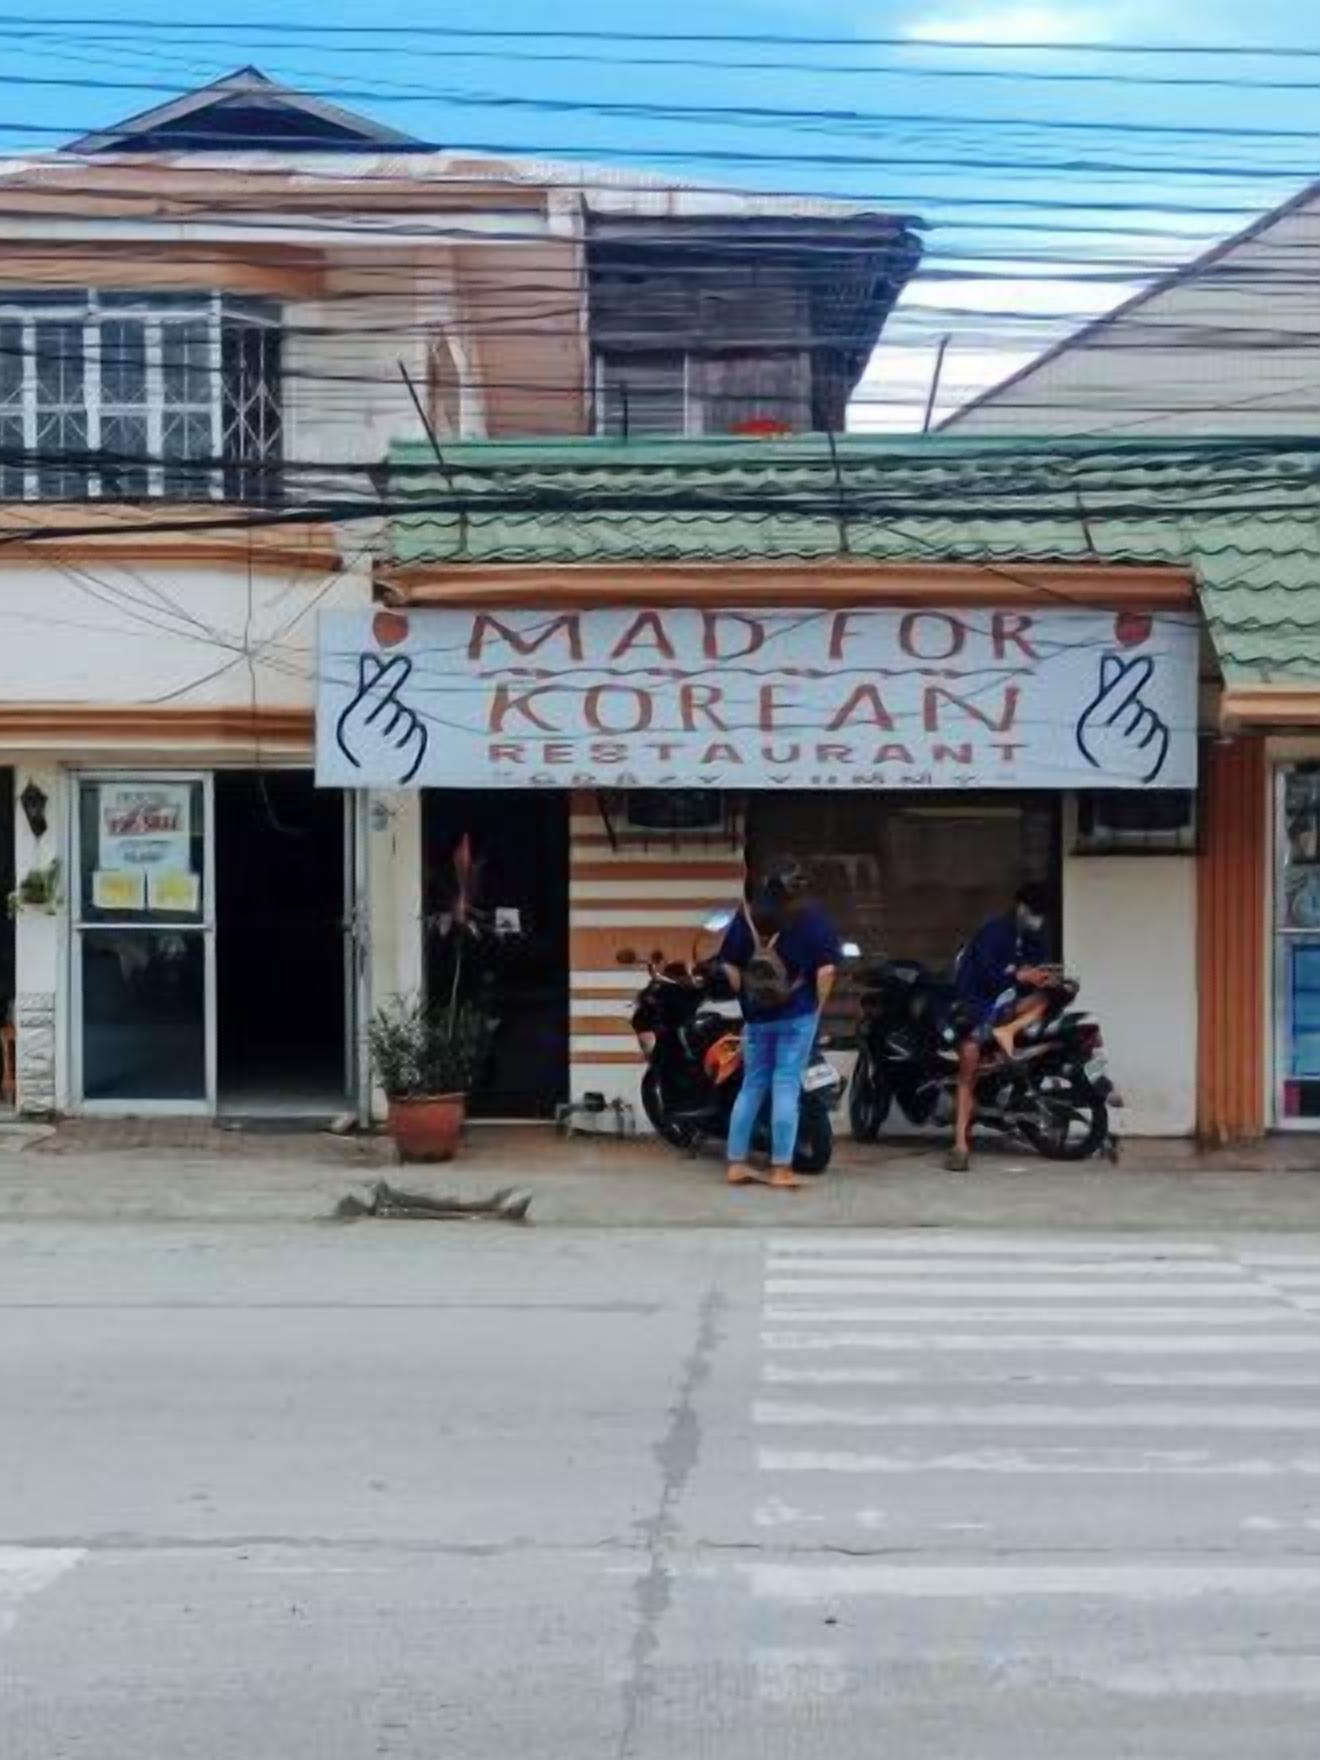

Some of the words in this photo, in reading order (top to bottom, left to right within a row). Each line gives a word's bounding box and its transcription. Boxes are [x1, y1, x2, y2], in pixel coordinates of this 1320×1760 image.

[467, 610, 766, 661] MAD
[828, 610, 1041, 661] FOR
[488, 683, 1021, 735] KOREAN
[488, 743, 1028, 765] RESTAURANT
